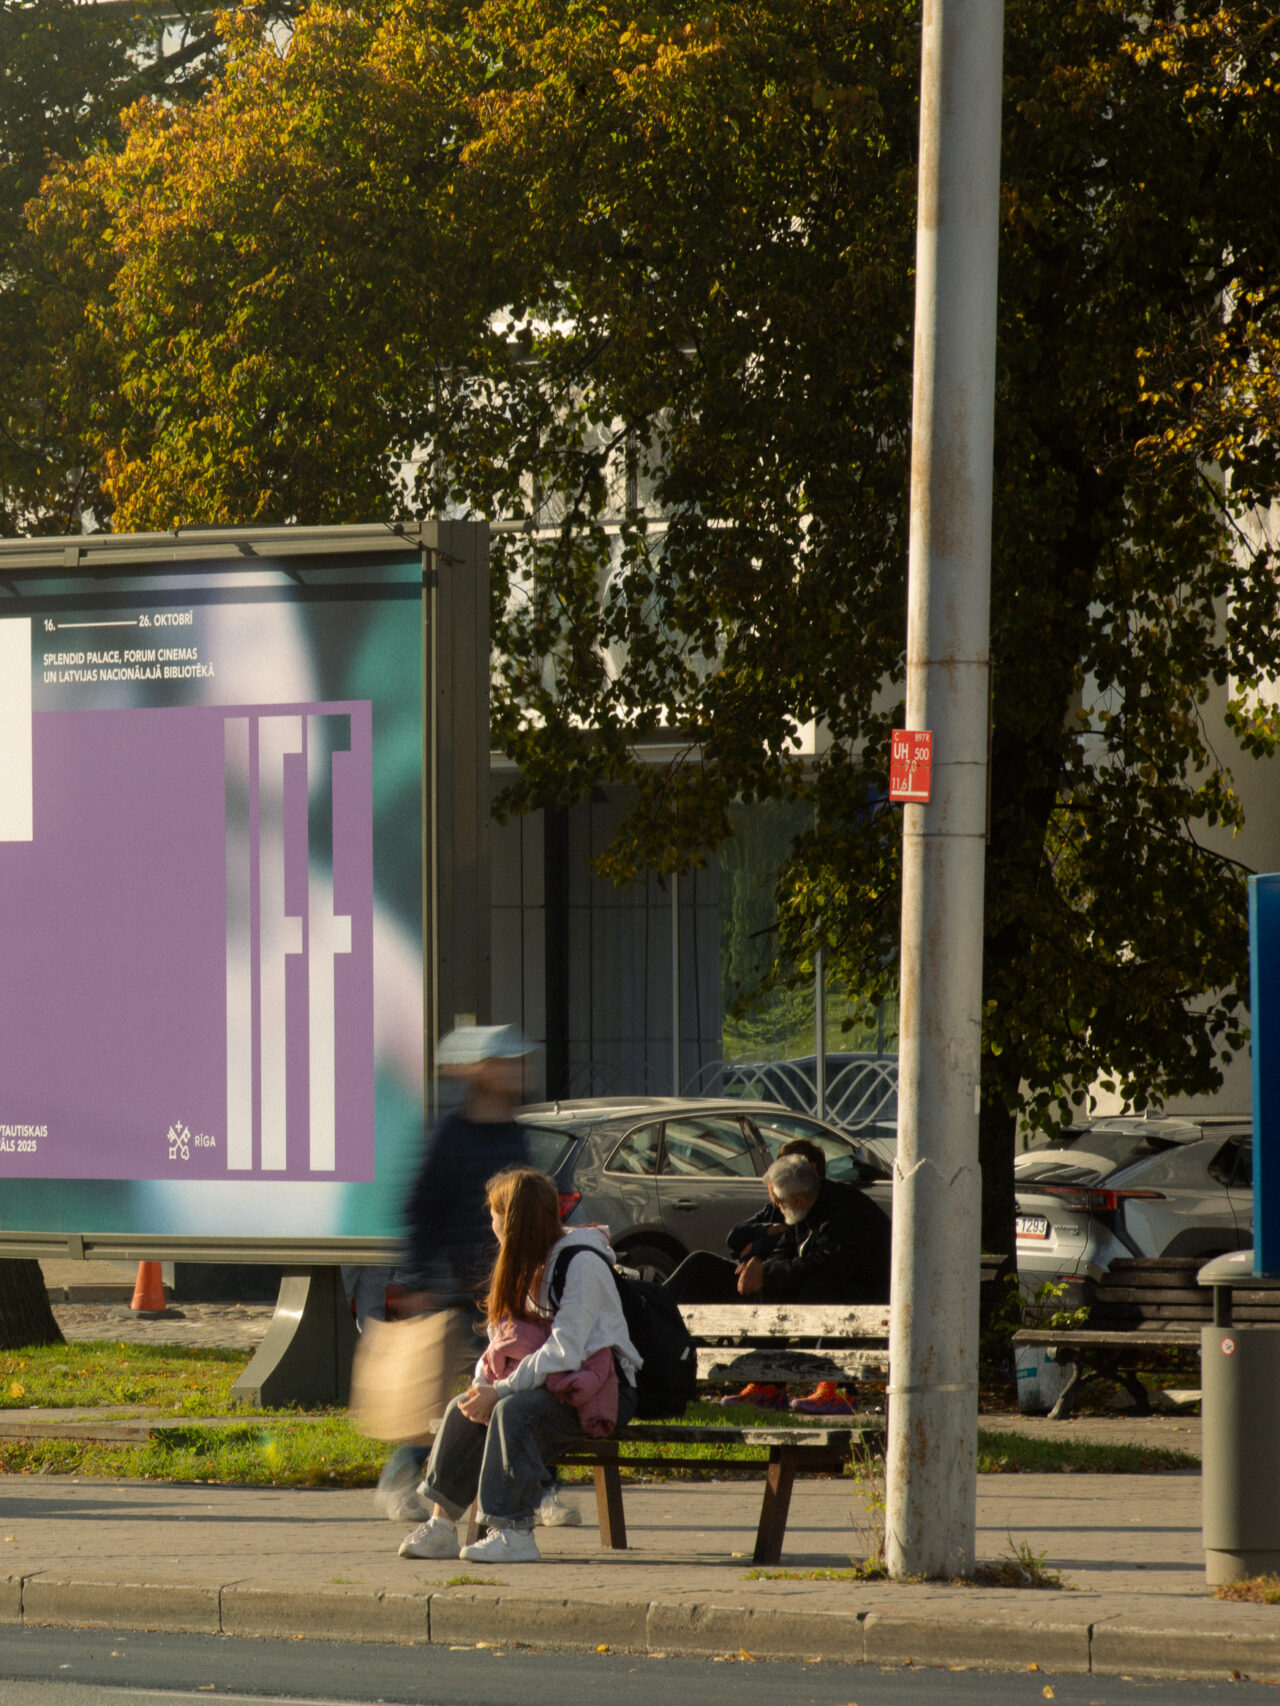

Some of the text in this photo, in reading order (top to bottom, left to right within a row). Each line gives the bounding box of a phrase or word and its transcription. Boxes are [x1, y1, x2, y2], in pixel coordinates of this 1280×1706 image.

[43, 610, 194, 632] 16. 26. OKTOBRĪ
[43, 648, 198, 667] SPLENDID PALACE, FORUM CINEMAS
[43, 662, 215, 683] UN LATVIJAS NACIONĀLAJĀ BIBLIOTĒKĀ
[893, 742, 930, 761] UH 500
[224, 713, 352, 1171] IFF
[17, 1140, 37, 1153] 2025
[194, 1132, 217, 1148] RĪGA
